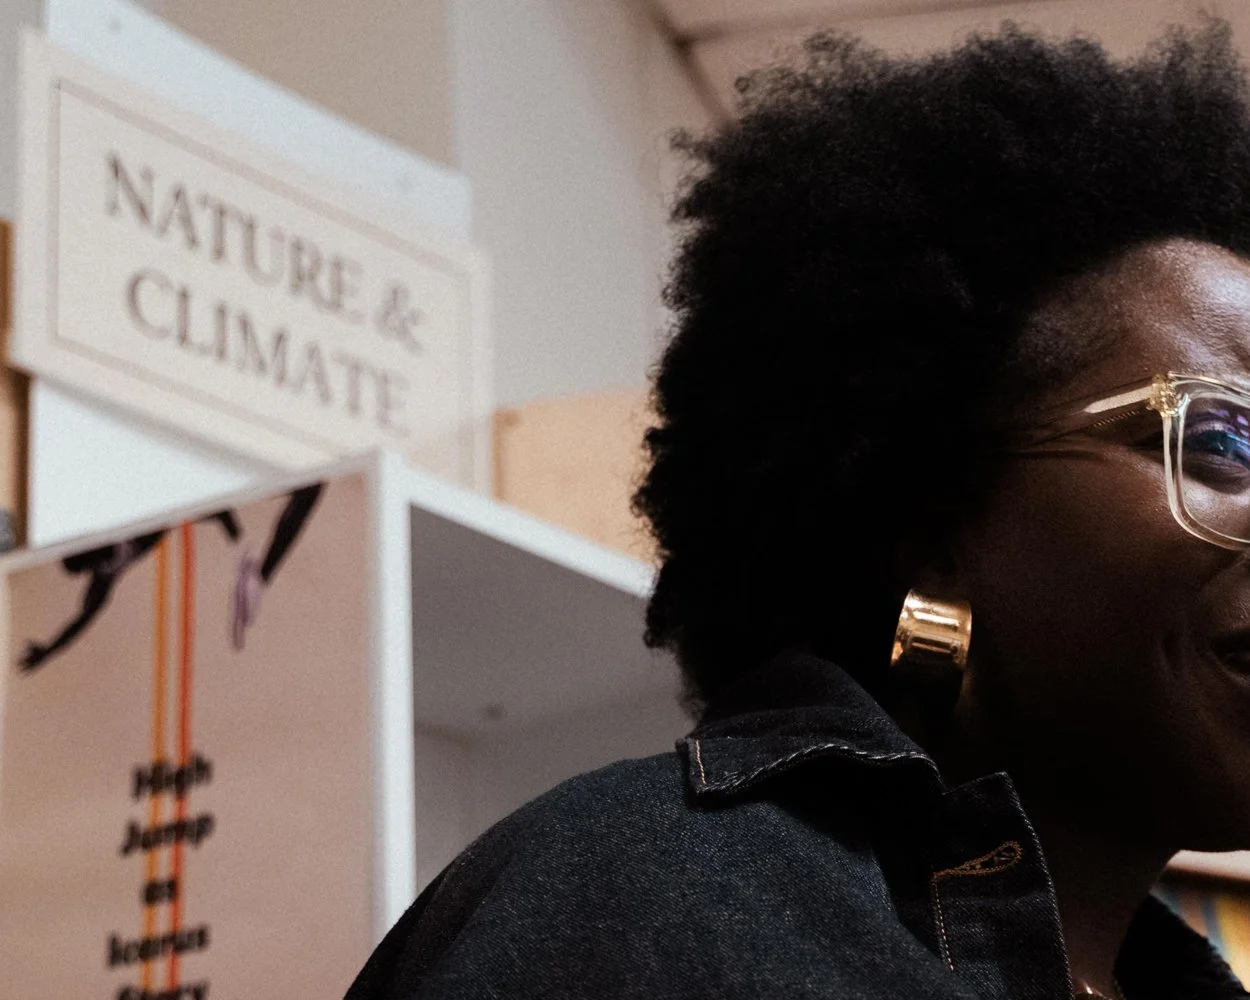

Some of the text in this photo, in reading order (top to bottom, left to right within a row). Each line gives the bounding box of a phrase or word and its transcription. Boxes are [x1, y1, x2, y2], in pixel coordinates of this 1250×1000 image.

[104, 150, 426, 356] NATURE &
[124, 267, 412, 440] CLIMATE
